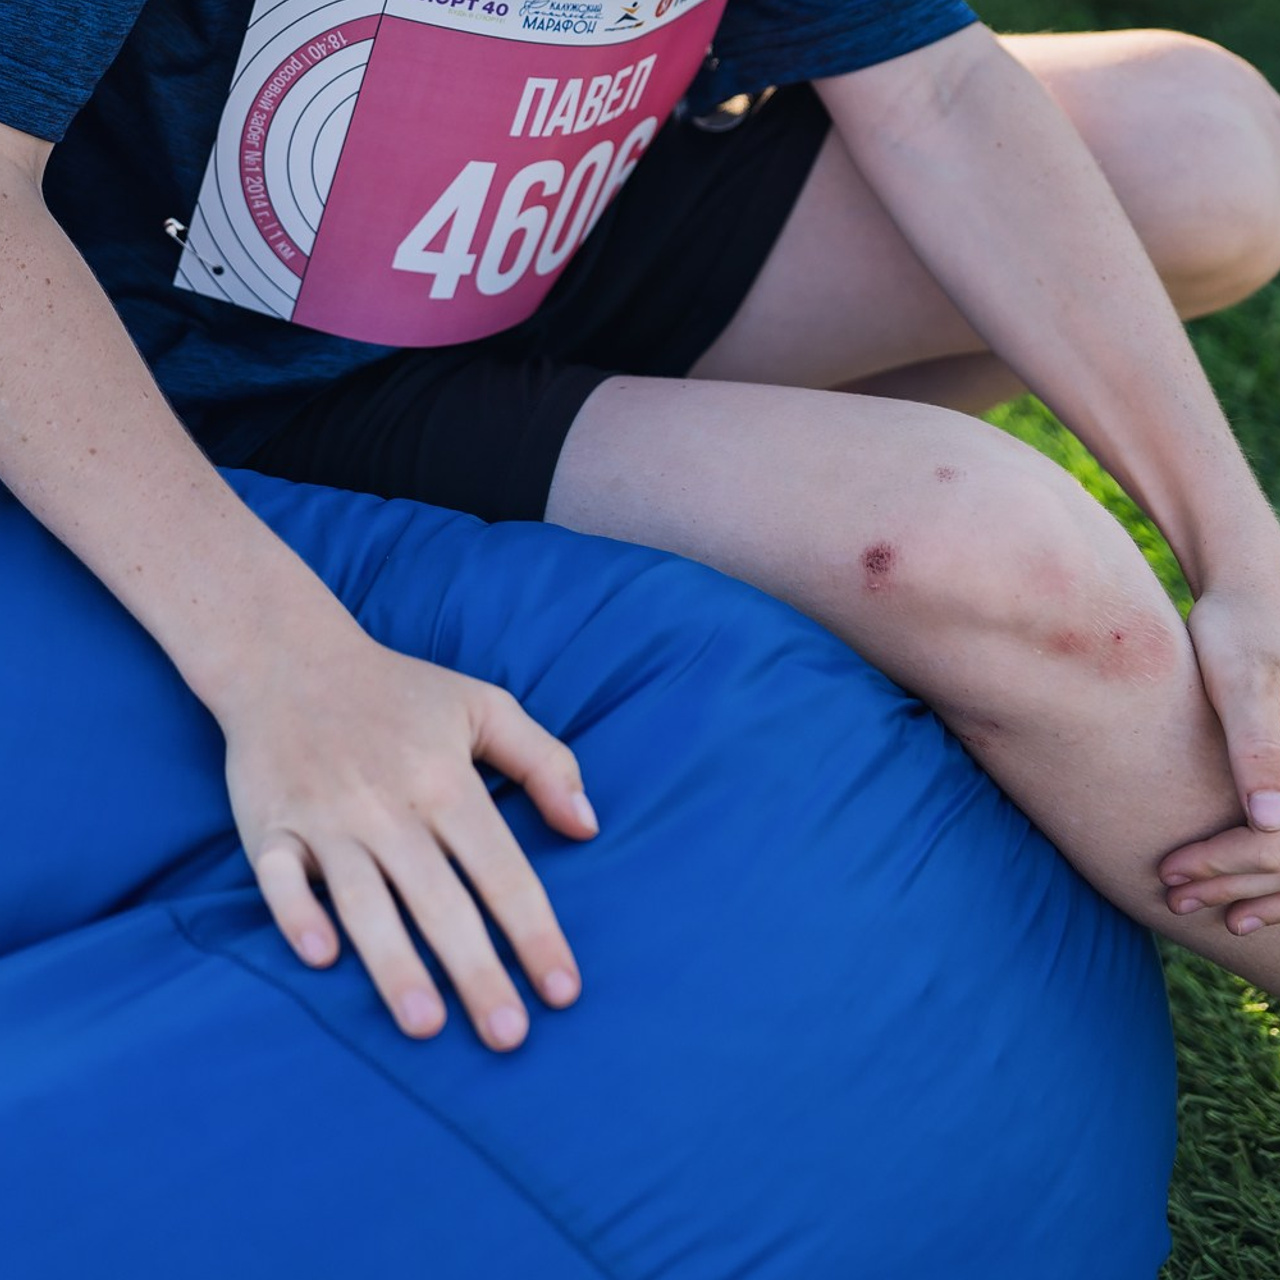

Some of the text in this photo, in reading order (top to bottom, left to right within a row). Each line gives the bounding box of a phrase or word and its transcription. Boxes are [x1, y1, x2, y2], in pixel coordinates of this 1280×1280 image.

[482, 0, 509, 17] 40
[522, 15, 598, 34] МАРАФОН
[307, 30, 348, 61] 18:40
[258, 55, 303, 111] розовый
[509, 53, 658, 138] ПАВЕЛ
[246, 111, 267, 148] забег
[246, 176, 269, 209] 2014
